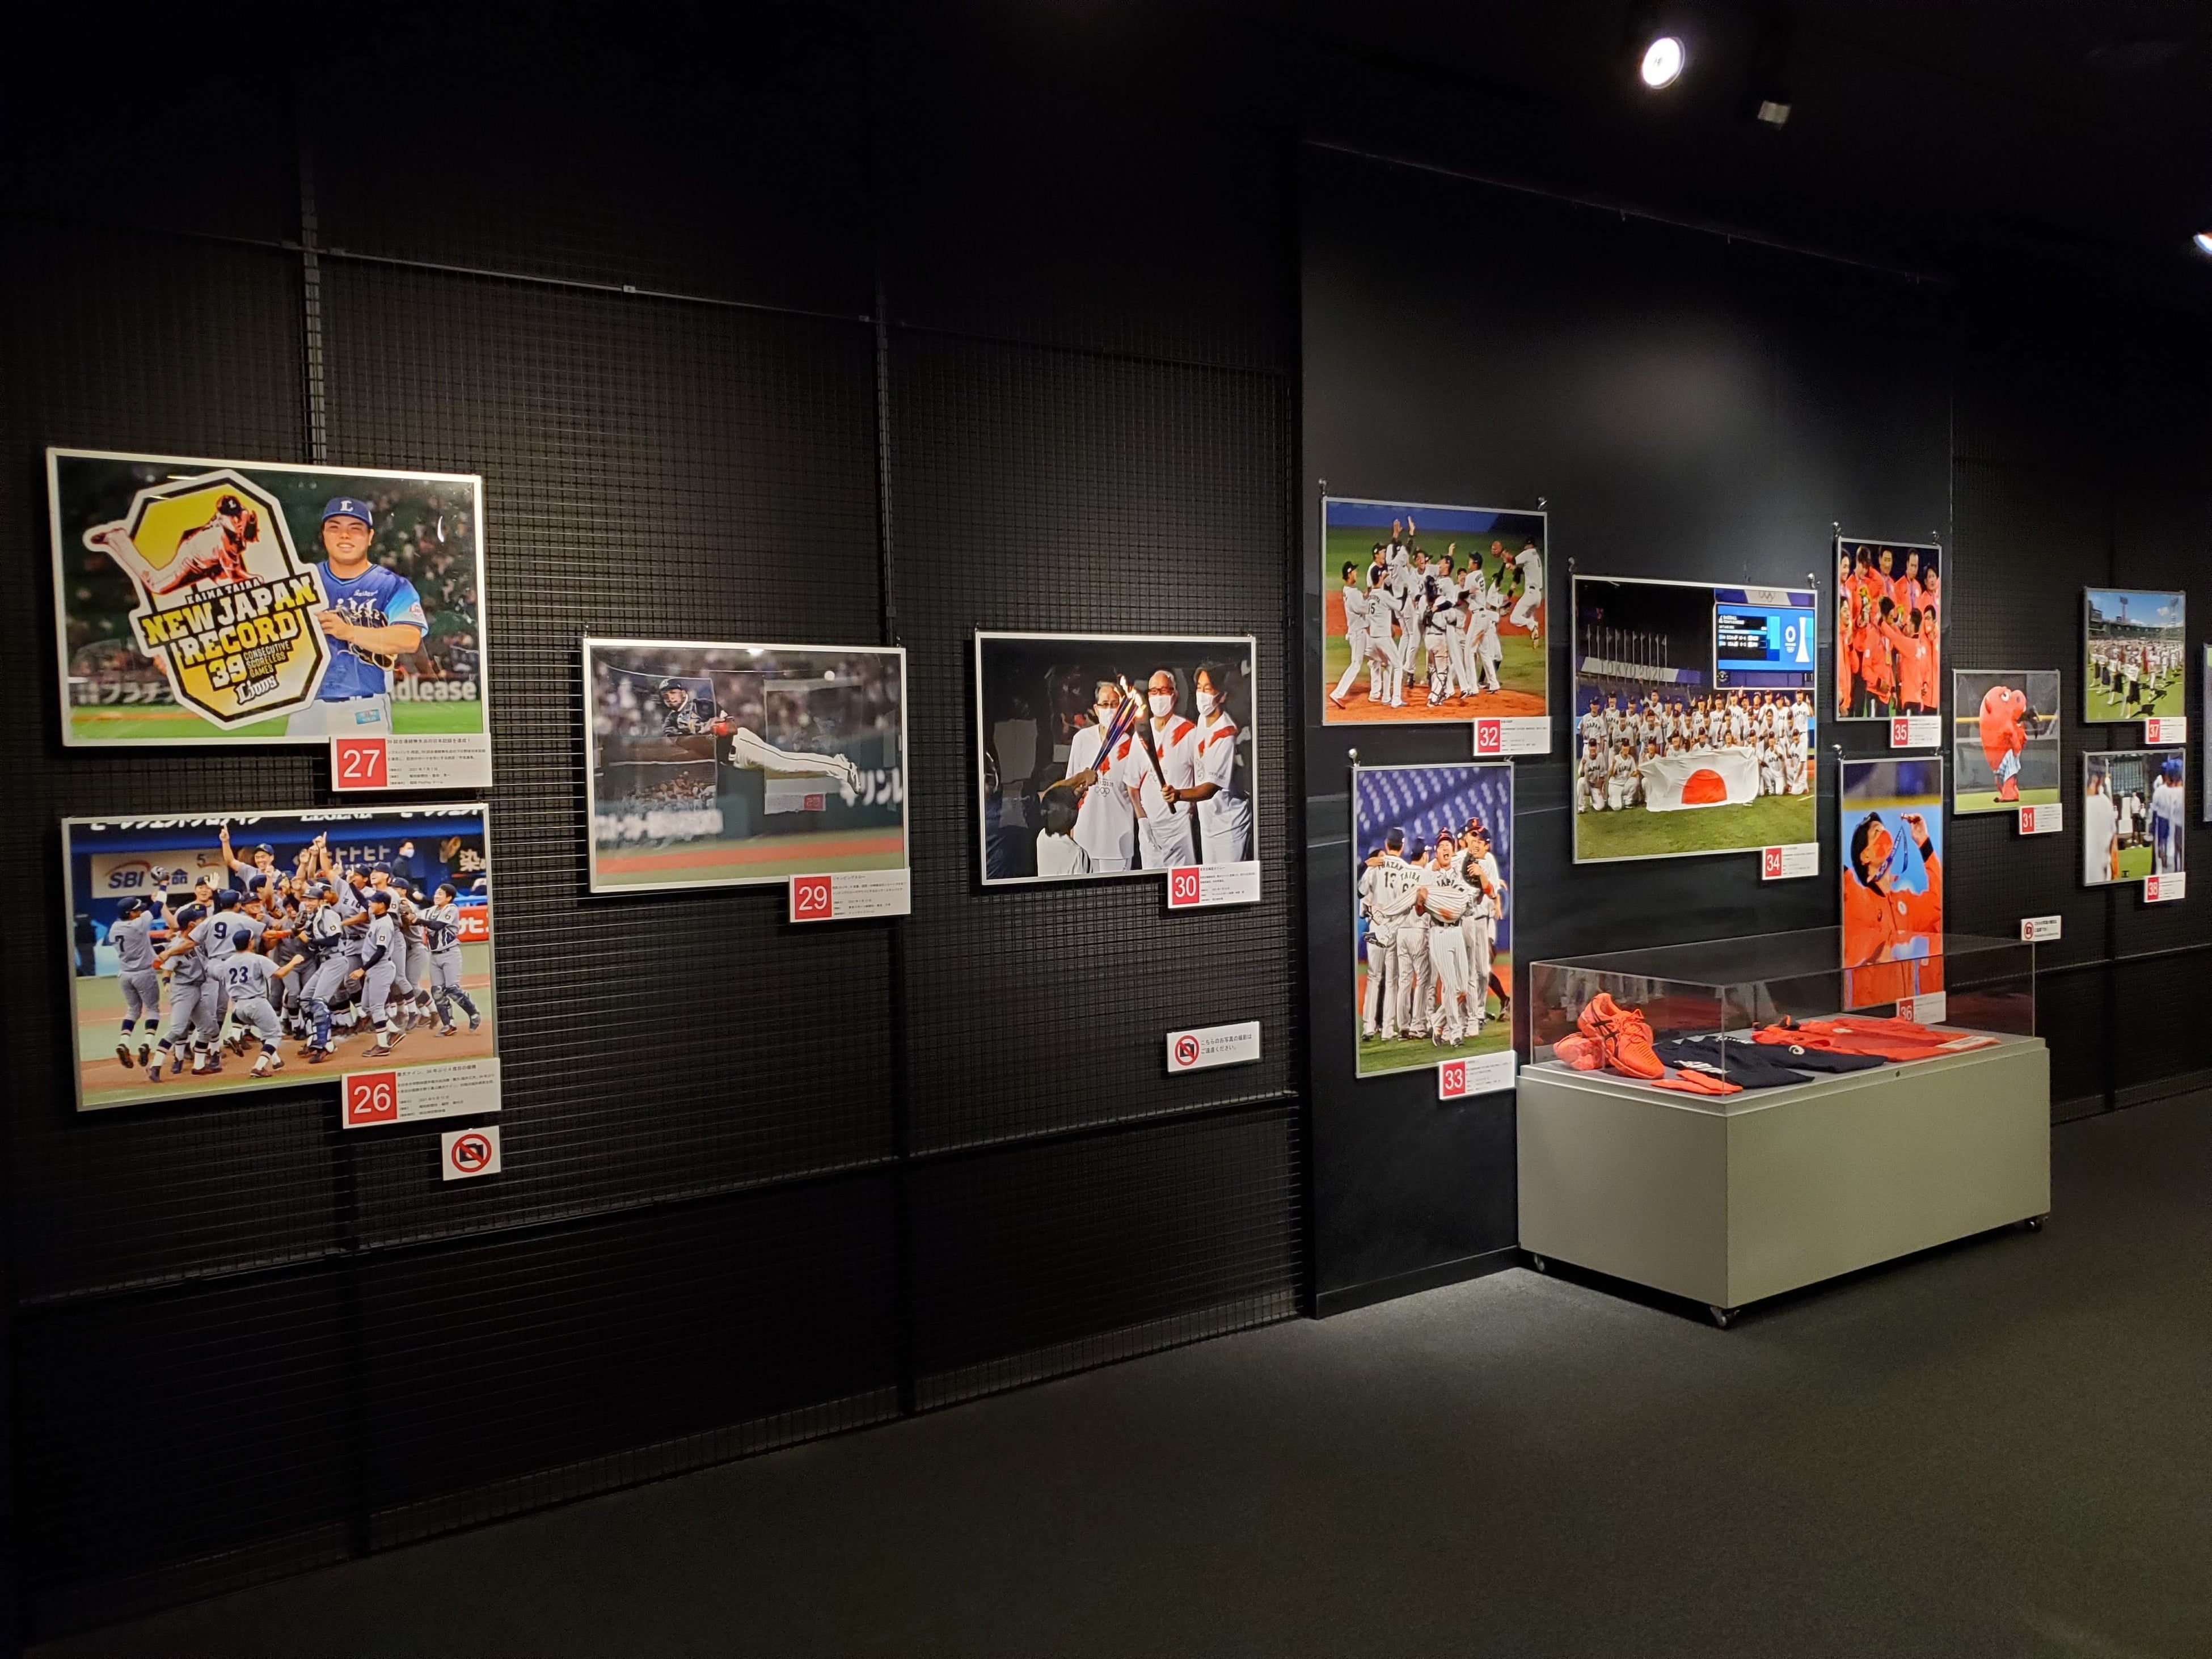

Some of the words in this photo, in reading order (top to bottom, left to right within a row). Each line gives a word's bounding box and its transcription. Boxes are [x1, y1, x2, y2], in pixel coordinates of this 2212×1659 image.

[340, 500, 353, 512] L
[142, 602, 213, 645] NEW
[217, 575, 316, 626] JAPAN
[179, 611, 298, 665] RECORD
[243, 641, 290, 661] CONSECUTIVE
[246, 652, 286, 669] SCORELESS
[1601, 660, 1636, 677] TOKYO
[208, 654, 247, 688] 39
[249, 664, 275, 678] GAMES
[392, 676, 477, 702] dlease
[1480, 727, 1498, 747] 32
[1894, 724, 1907, 740] 35
[2149, 724, 2160, 738] 37
[343, 749, 380, 778] 27
[2023, 813, 2033, 828] 31
[1766, 854, 1780, 872] 34
[108, 871, 144, 889] SBI
[1175, 875, 1196, 898] 30
[799, 885, 828, 911] 29
[214, 922, 227, 939] 9
[115, 935, 125, 952] 7
[229, 966, 248, 985] 23
[1901, 1005, 1913, 1020] 36
[1445, 1068, 1463, 1090] 33
[354, 1083, 391, 1114] 26
